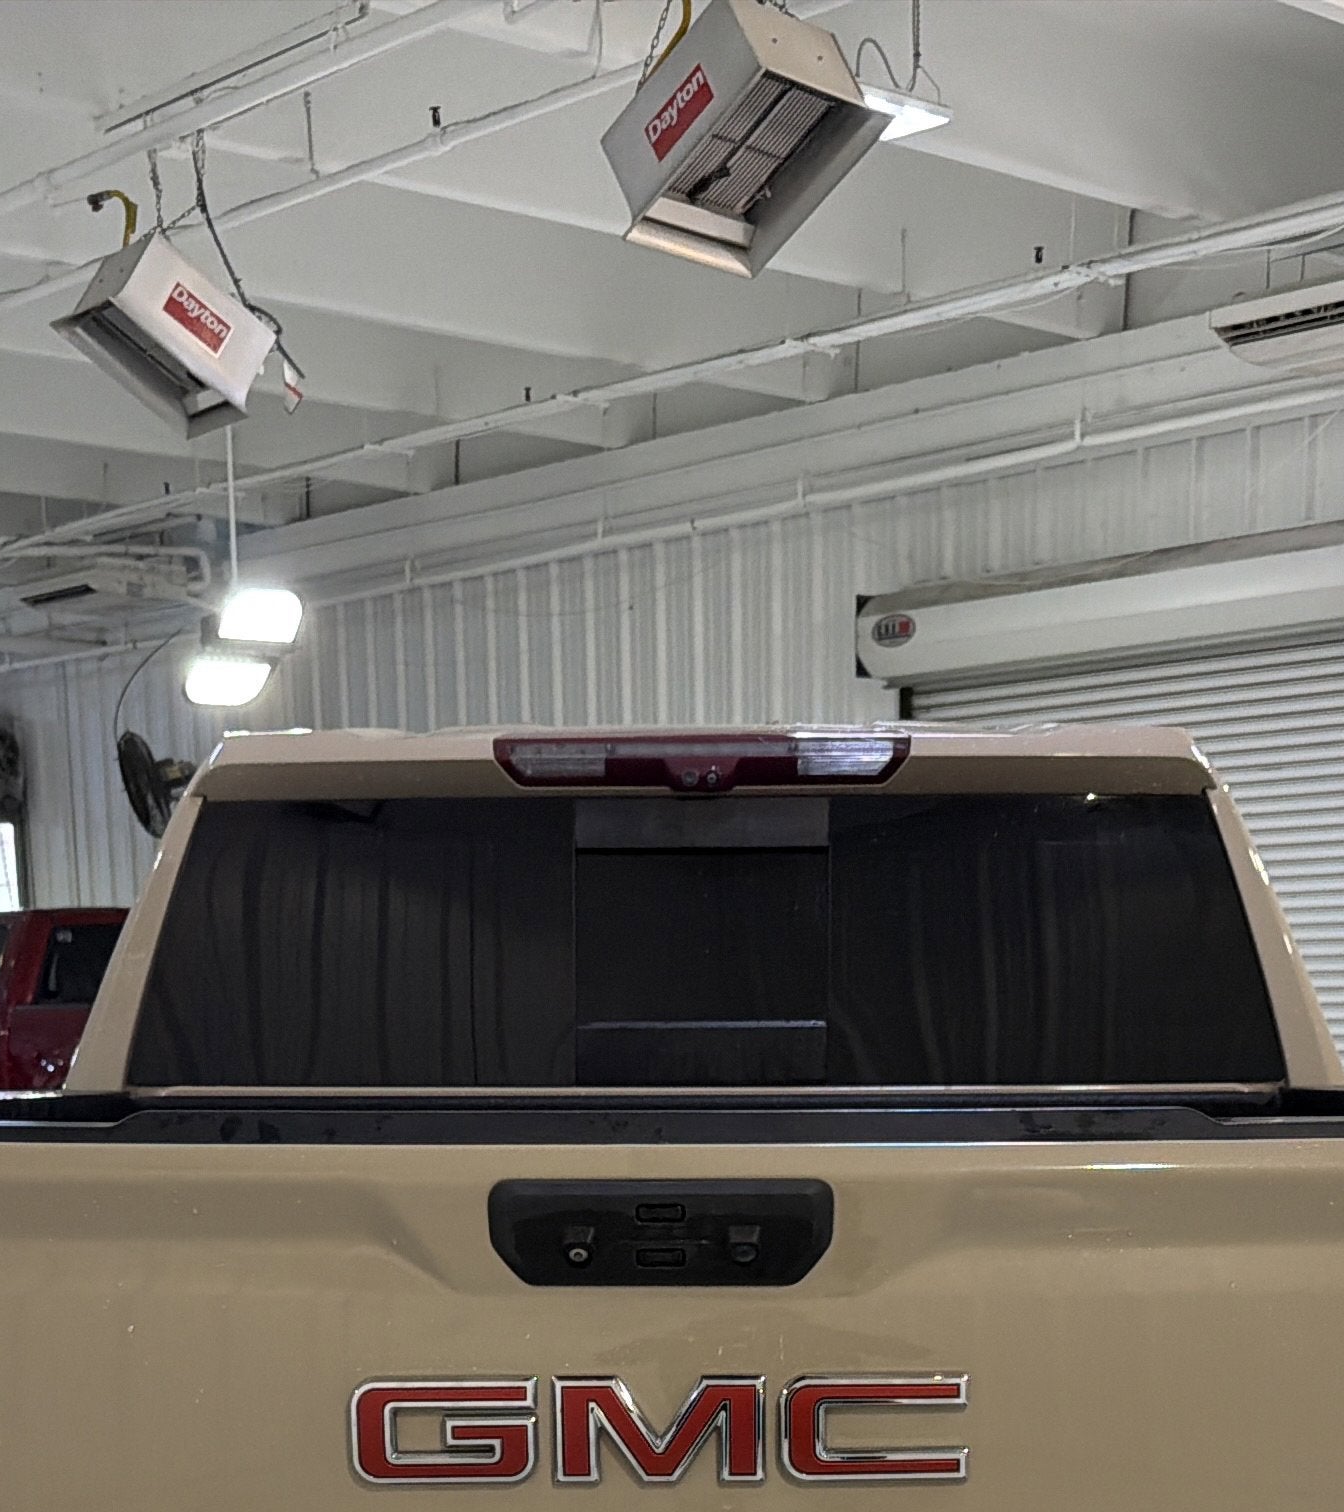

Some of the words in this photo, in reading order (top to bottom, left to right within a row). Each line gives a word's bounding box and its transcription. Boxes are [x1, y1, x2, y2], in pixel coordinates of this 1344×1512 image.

[648, 70, 704, 144] Dayton
[172, 287, 228, 338] Dayton
[350, 1375, 969, 1484] GMC
